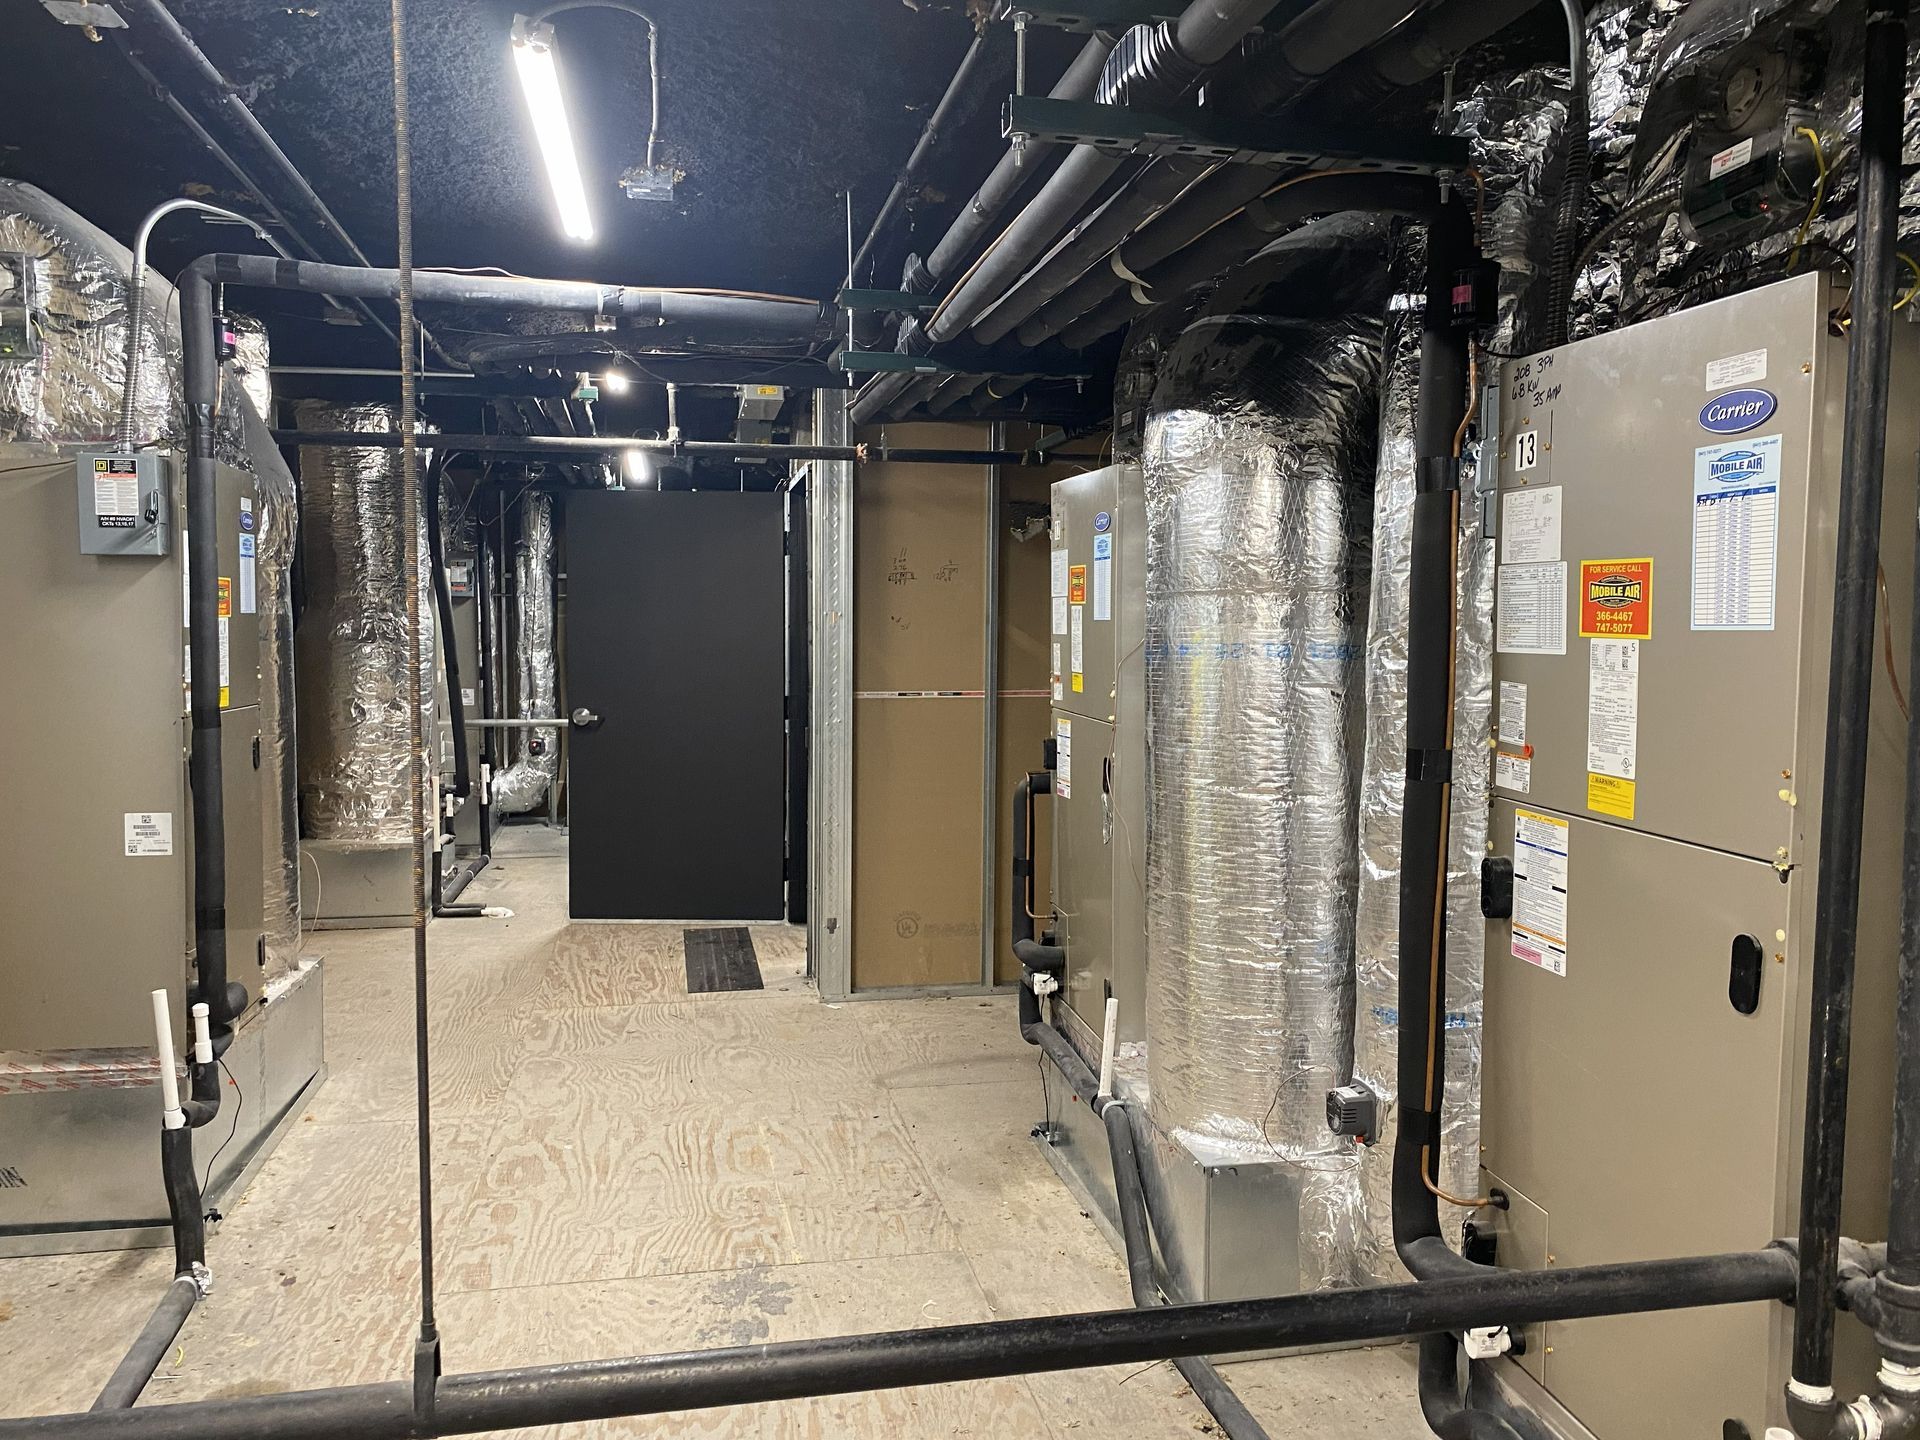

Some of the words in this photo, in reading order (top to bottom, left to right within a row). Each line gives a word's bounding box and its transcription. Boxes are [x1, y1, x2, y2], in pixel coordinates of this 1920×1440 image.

[1513, 364, 1531, 382] 208
[1537, 354, 1554, 374] 3PH
[1533, 391, 1545, 407] 35
[1707, 400, 1764, 422] Carrier
[1519, 434, 1535, 468] 13
[1710, 461, 1745, 477] MOBILE
[1746, 456, 1763, 470] AIR
[1590, 566, 1601, 574] FOR
[1602, 565, 1627, 573] SERVICE
[1627, 564, 1643, 572] CALL
[1591, 584, 1623, 599] MOBILE
[1624, 583, 1640, 599] AIR
[1596, 611, 1633, 621] 366-4467
[1596, 623, 1633, 633] 747-5077
